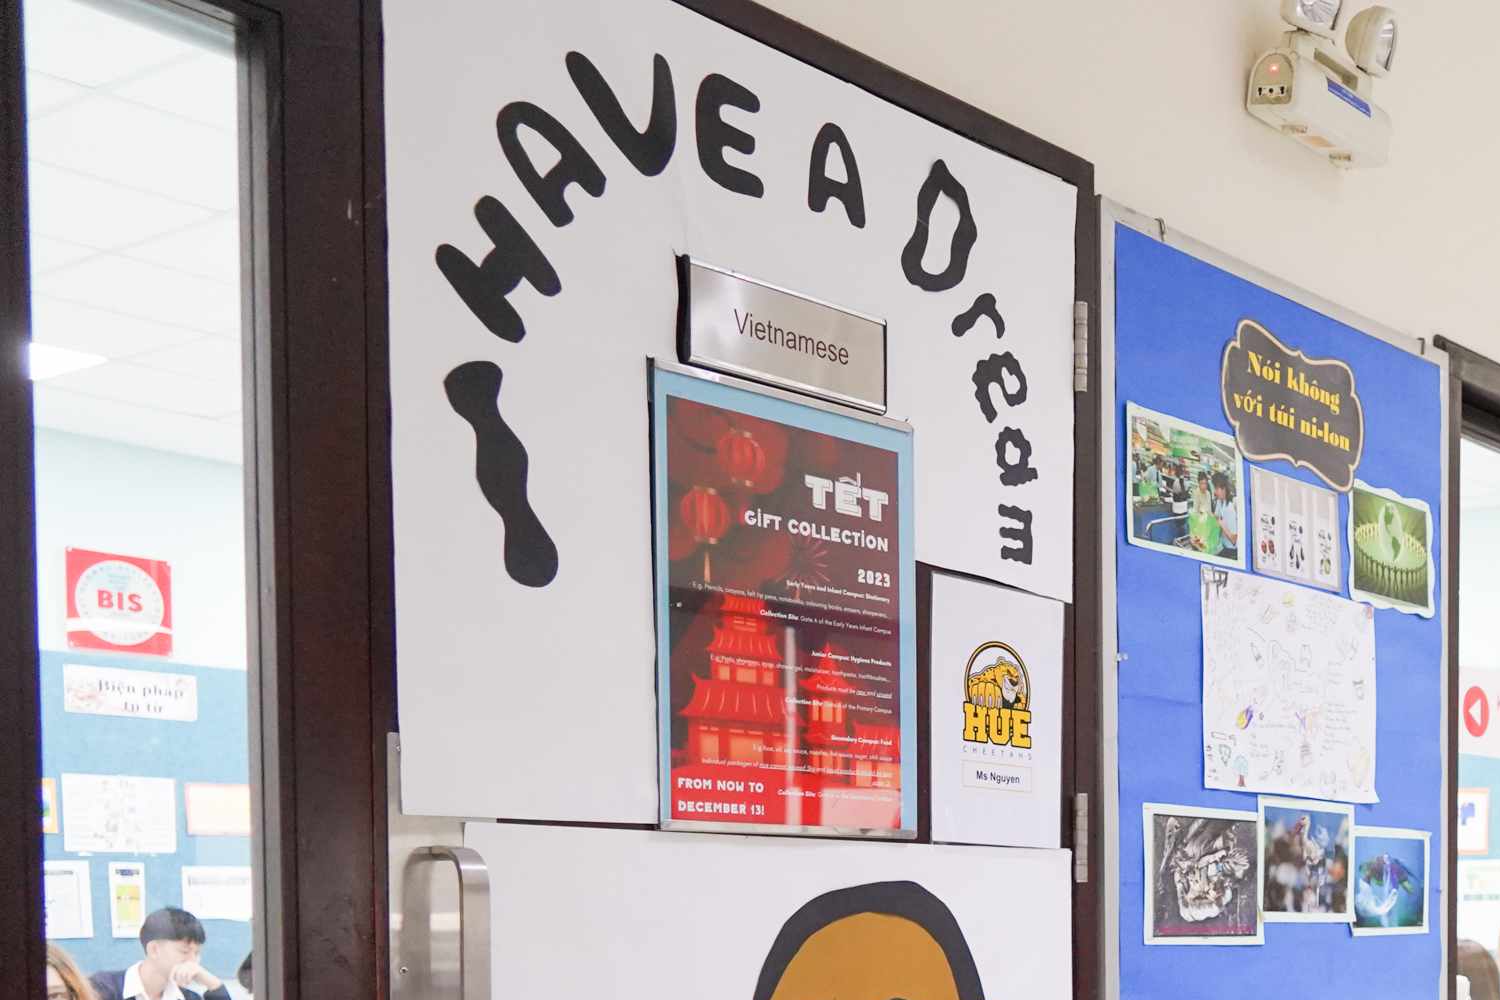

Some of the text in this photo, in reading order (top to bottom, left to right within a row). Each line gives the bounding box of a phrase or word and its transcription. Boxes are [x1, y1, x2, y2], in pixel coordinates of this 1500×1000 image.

[435, 50, 1038, 588] I HAVE A Dream
[734, 308, 849, 365] Vietnamese
[1247, 350, 1340, 416] Nói không
[1232, 389, 1350, 452] với túi ni-lon
[804, 471, 889, 522] TẾT
[96, 588, 144, 613] BIS
[857, 567, 891, 587] 2023
[963, 700, 1032, 750] HUE
[677, 777, 765, 793] FROM NOW TO
[976, 769, 1020, 785] Ms Nguyen
[677, 800, 765, 816] DECEMBER 13!
